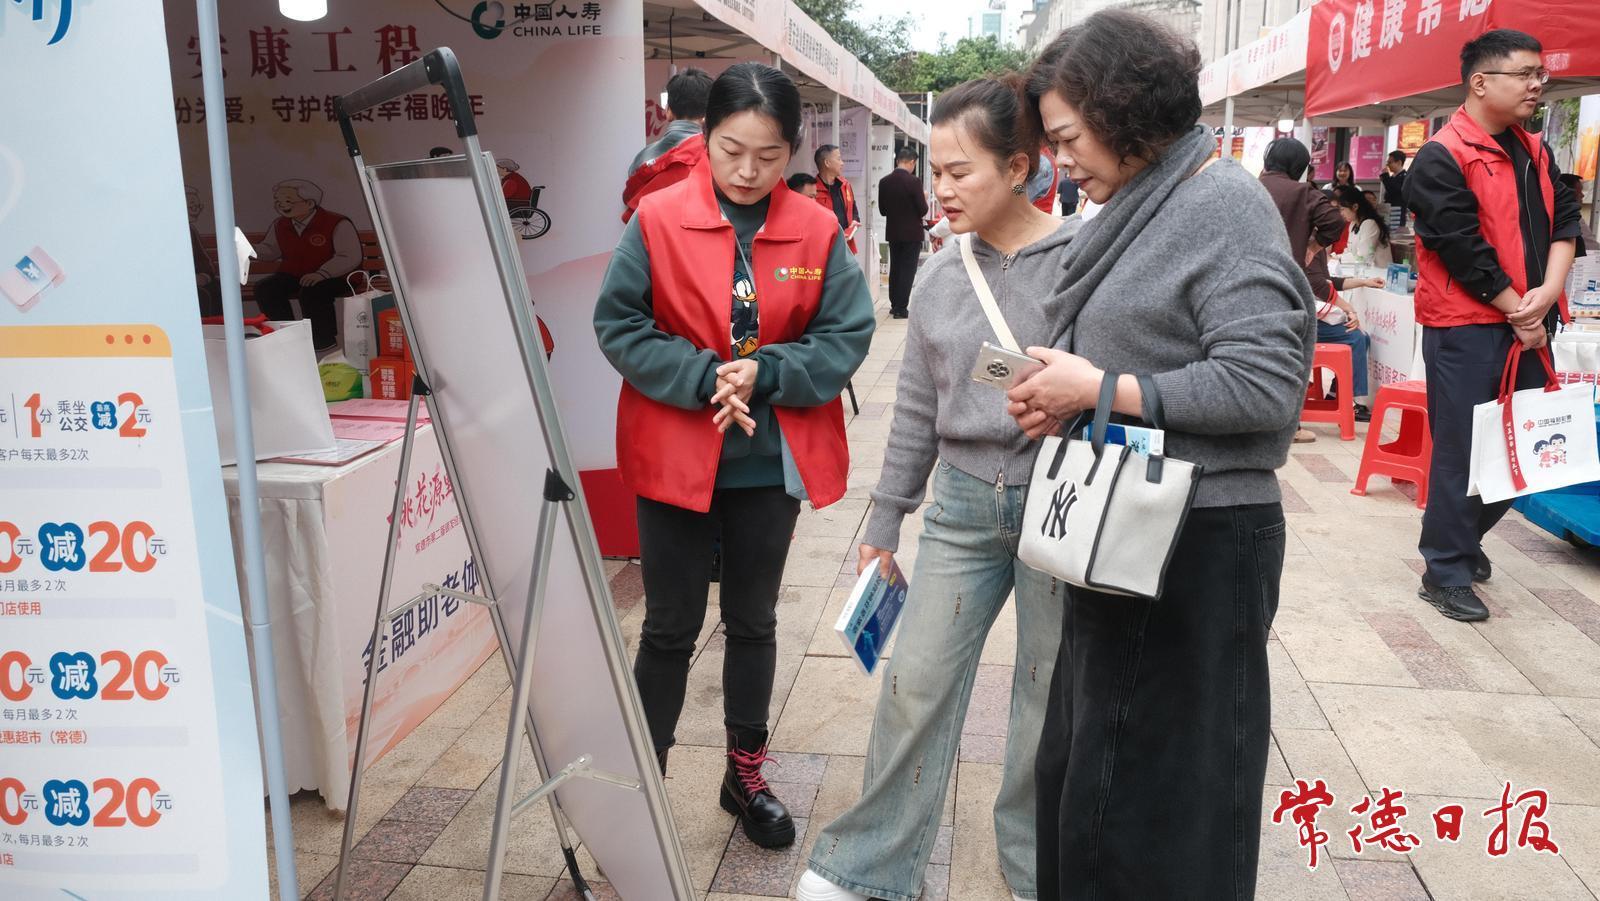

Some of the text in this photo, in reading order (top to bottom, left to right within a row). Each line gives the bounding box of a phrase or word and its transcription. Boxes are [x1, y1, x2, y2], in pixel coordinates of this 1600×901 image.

[513, 2, 602, 21] 中国人寿
[513, 25, 602, 38] CHINA LIFE
[57, 400, 87, 416] 乘坐
[59, 416, 89, 433] 公交
